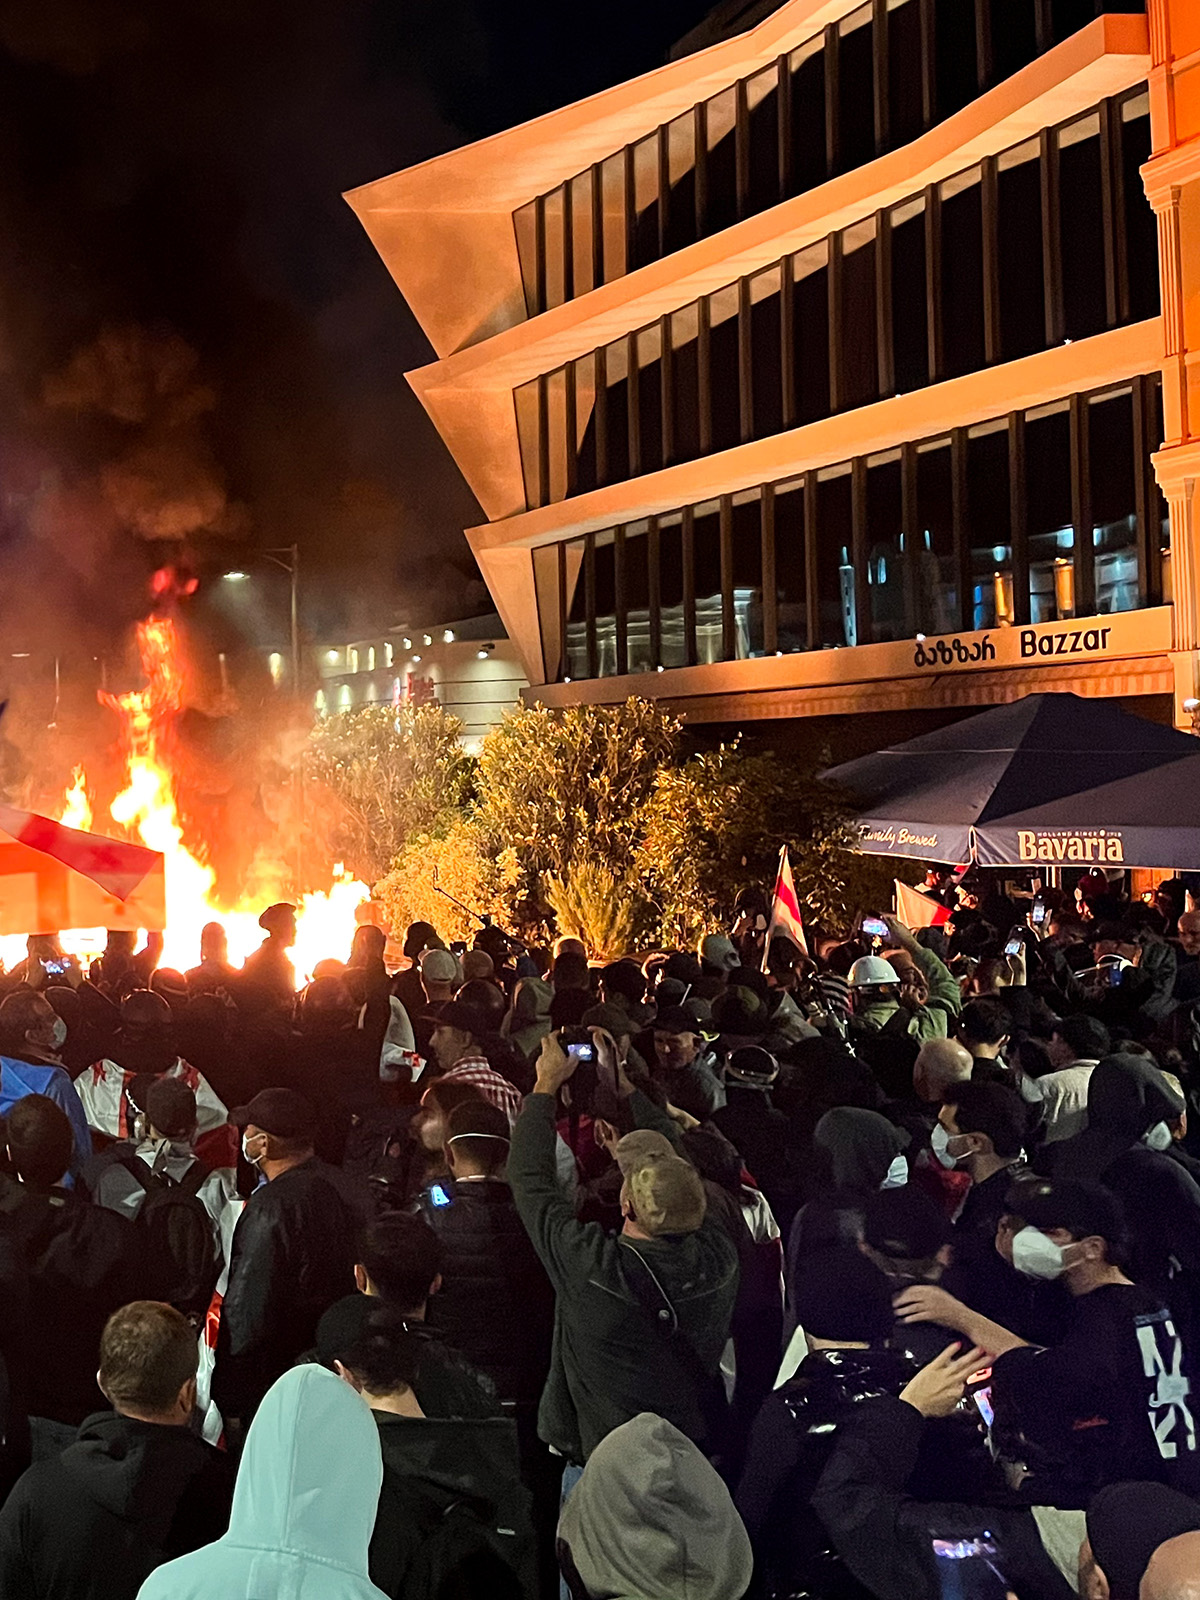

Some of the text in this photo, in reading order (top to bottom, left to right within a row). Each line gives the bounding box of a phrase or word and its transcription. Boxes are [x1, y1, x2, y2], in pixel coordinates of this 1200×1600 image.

[914, 635, 995, 667] ბაზზარ
[1020, 628, 1111, 658] Bazzar
[858, 824, 937, 849] Family Brewed
[1018, 830, 1124, 862] Bavaria
